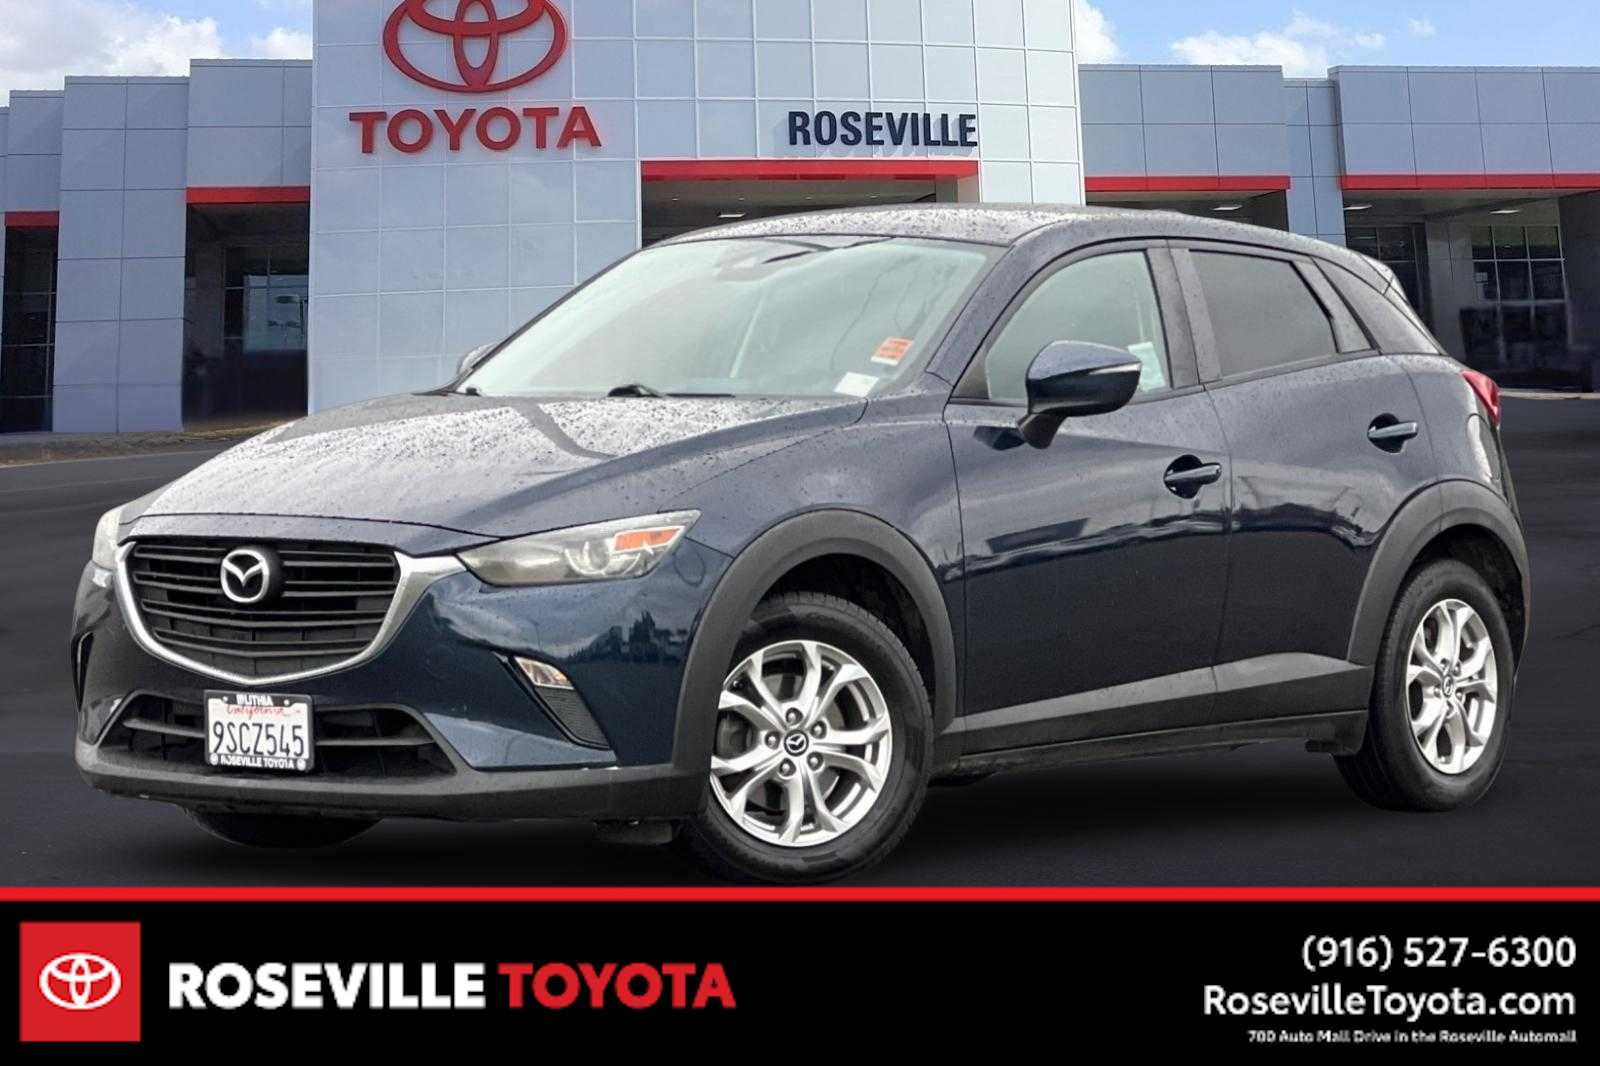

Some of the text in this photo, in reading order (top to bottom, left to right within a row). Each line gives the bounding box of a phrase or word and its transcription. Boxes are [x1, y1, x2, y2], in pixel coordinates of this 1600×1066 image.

[349, 106, 602, 154] TOYOTA
[788, 110, 979, 148] ROSEVILLE
[213, 720, 305, 757] 9SCZ545
[220, 754, 295, 770] ROSEVILLE TOYOTA
